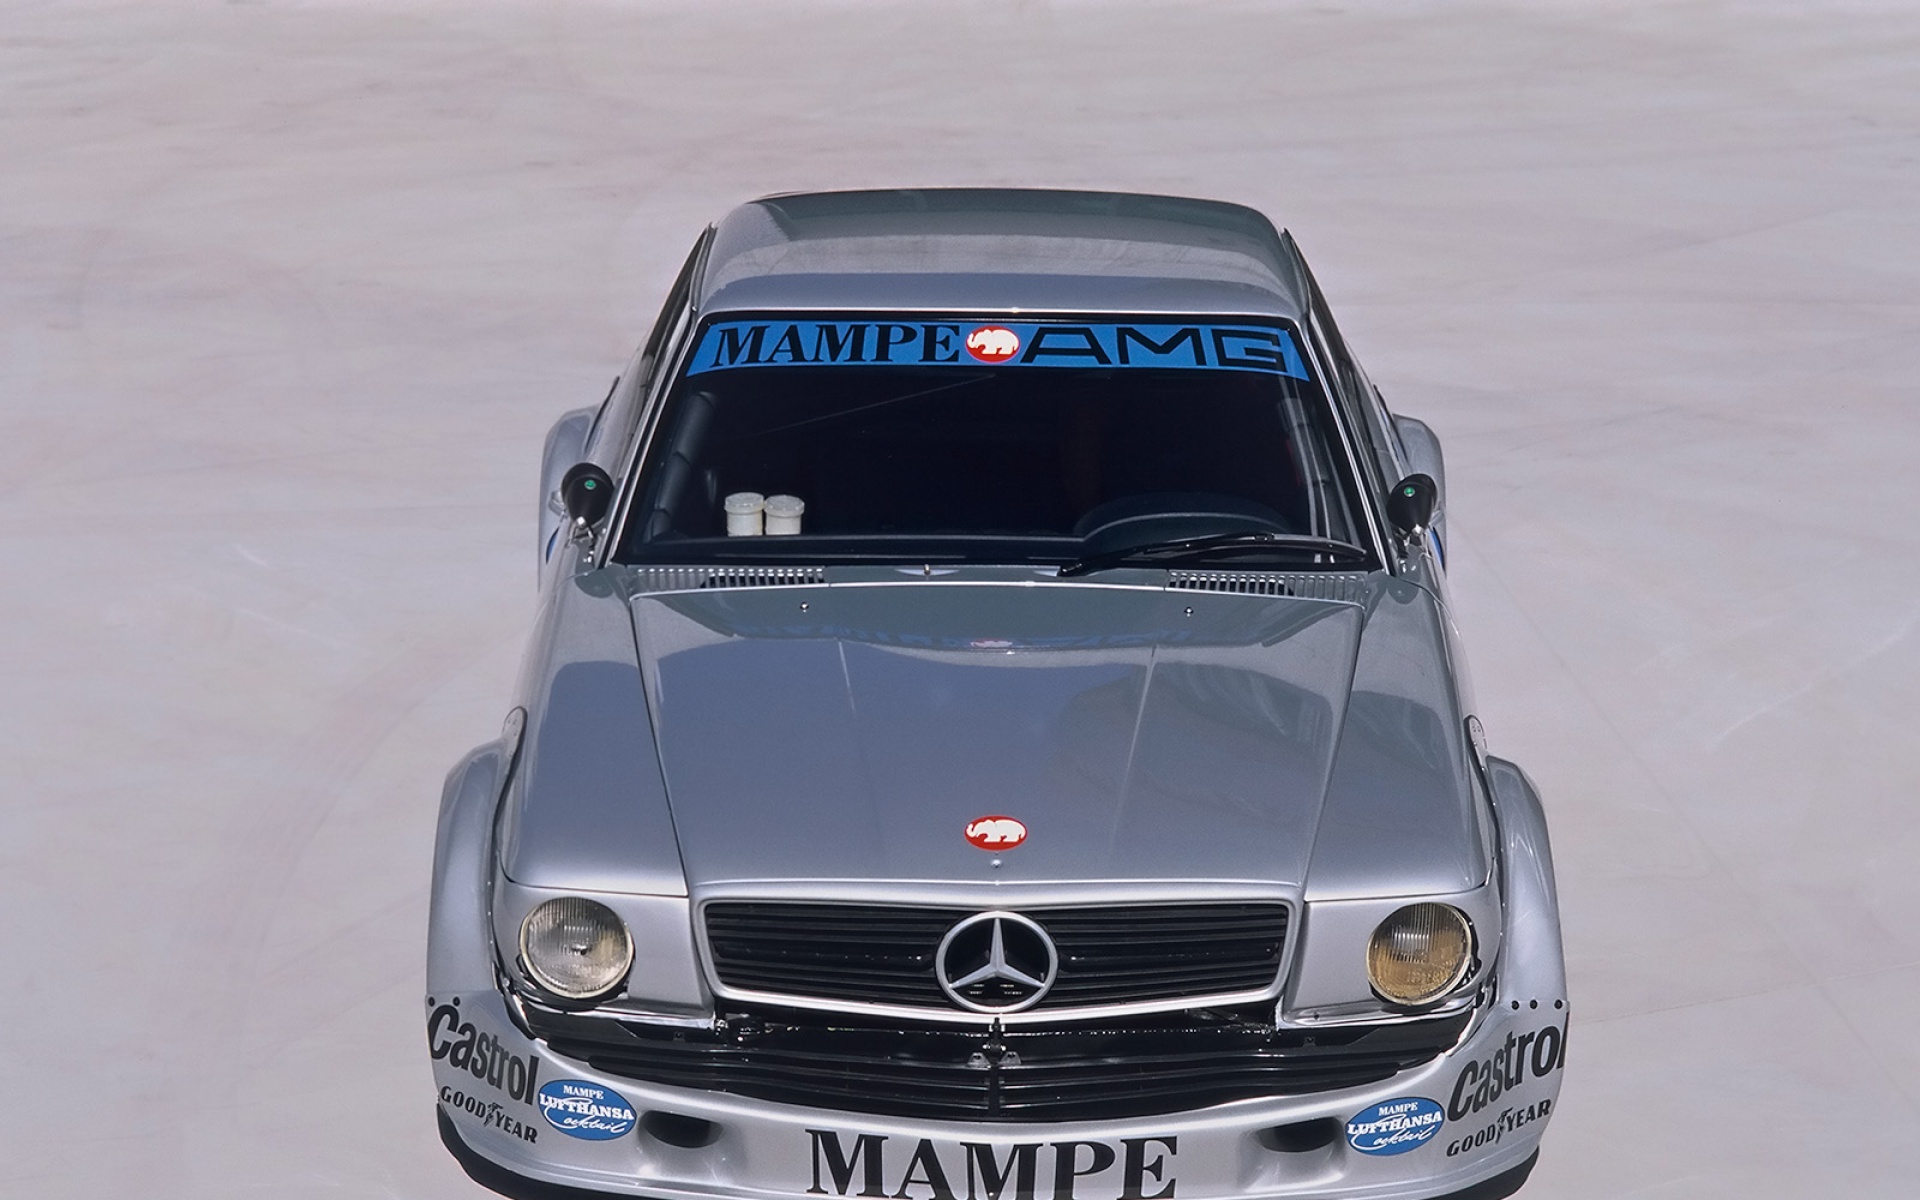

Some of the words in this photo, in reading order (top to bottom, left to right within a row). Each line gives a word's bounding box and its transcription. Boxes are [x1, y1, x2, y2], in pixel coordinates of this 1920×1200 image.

[712, 323, 960, 368] MAMPE
[1020, 325, 1288, 373] AMG
[427, 1004, 540, 1106] Castrol
[1446, 1012, 1570, 1122] Castrol
[440, 1085, 538, 1144] GOODYEAR
[539, 1092, 635, 1121] LUFTHANSA
[563, 1084, 605, 1100] MAMPE
[1378, 1101, 1419, 1116] MAMPE
[1347, 1110, 1443, 1135] LUFTHANSA
[1446, 1098, 1552, 1157] GOODYEAR
[805, 1128, 1178, 1200] MAMPE
